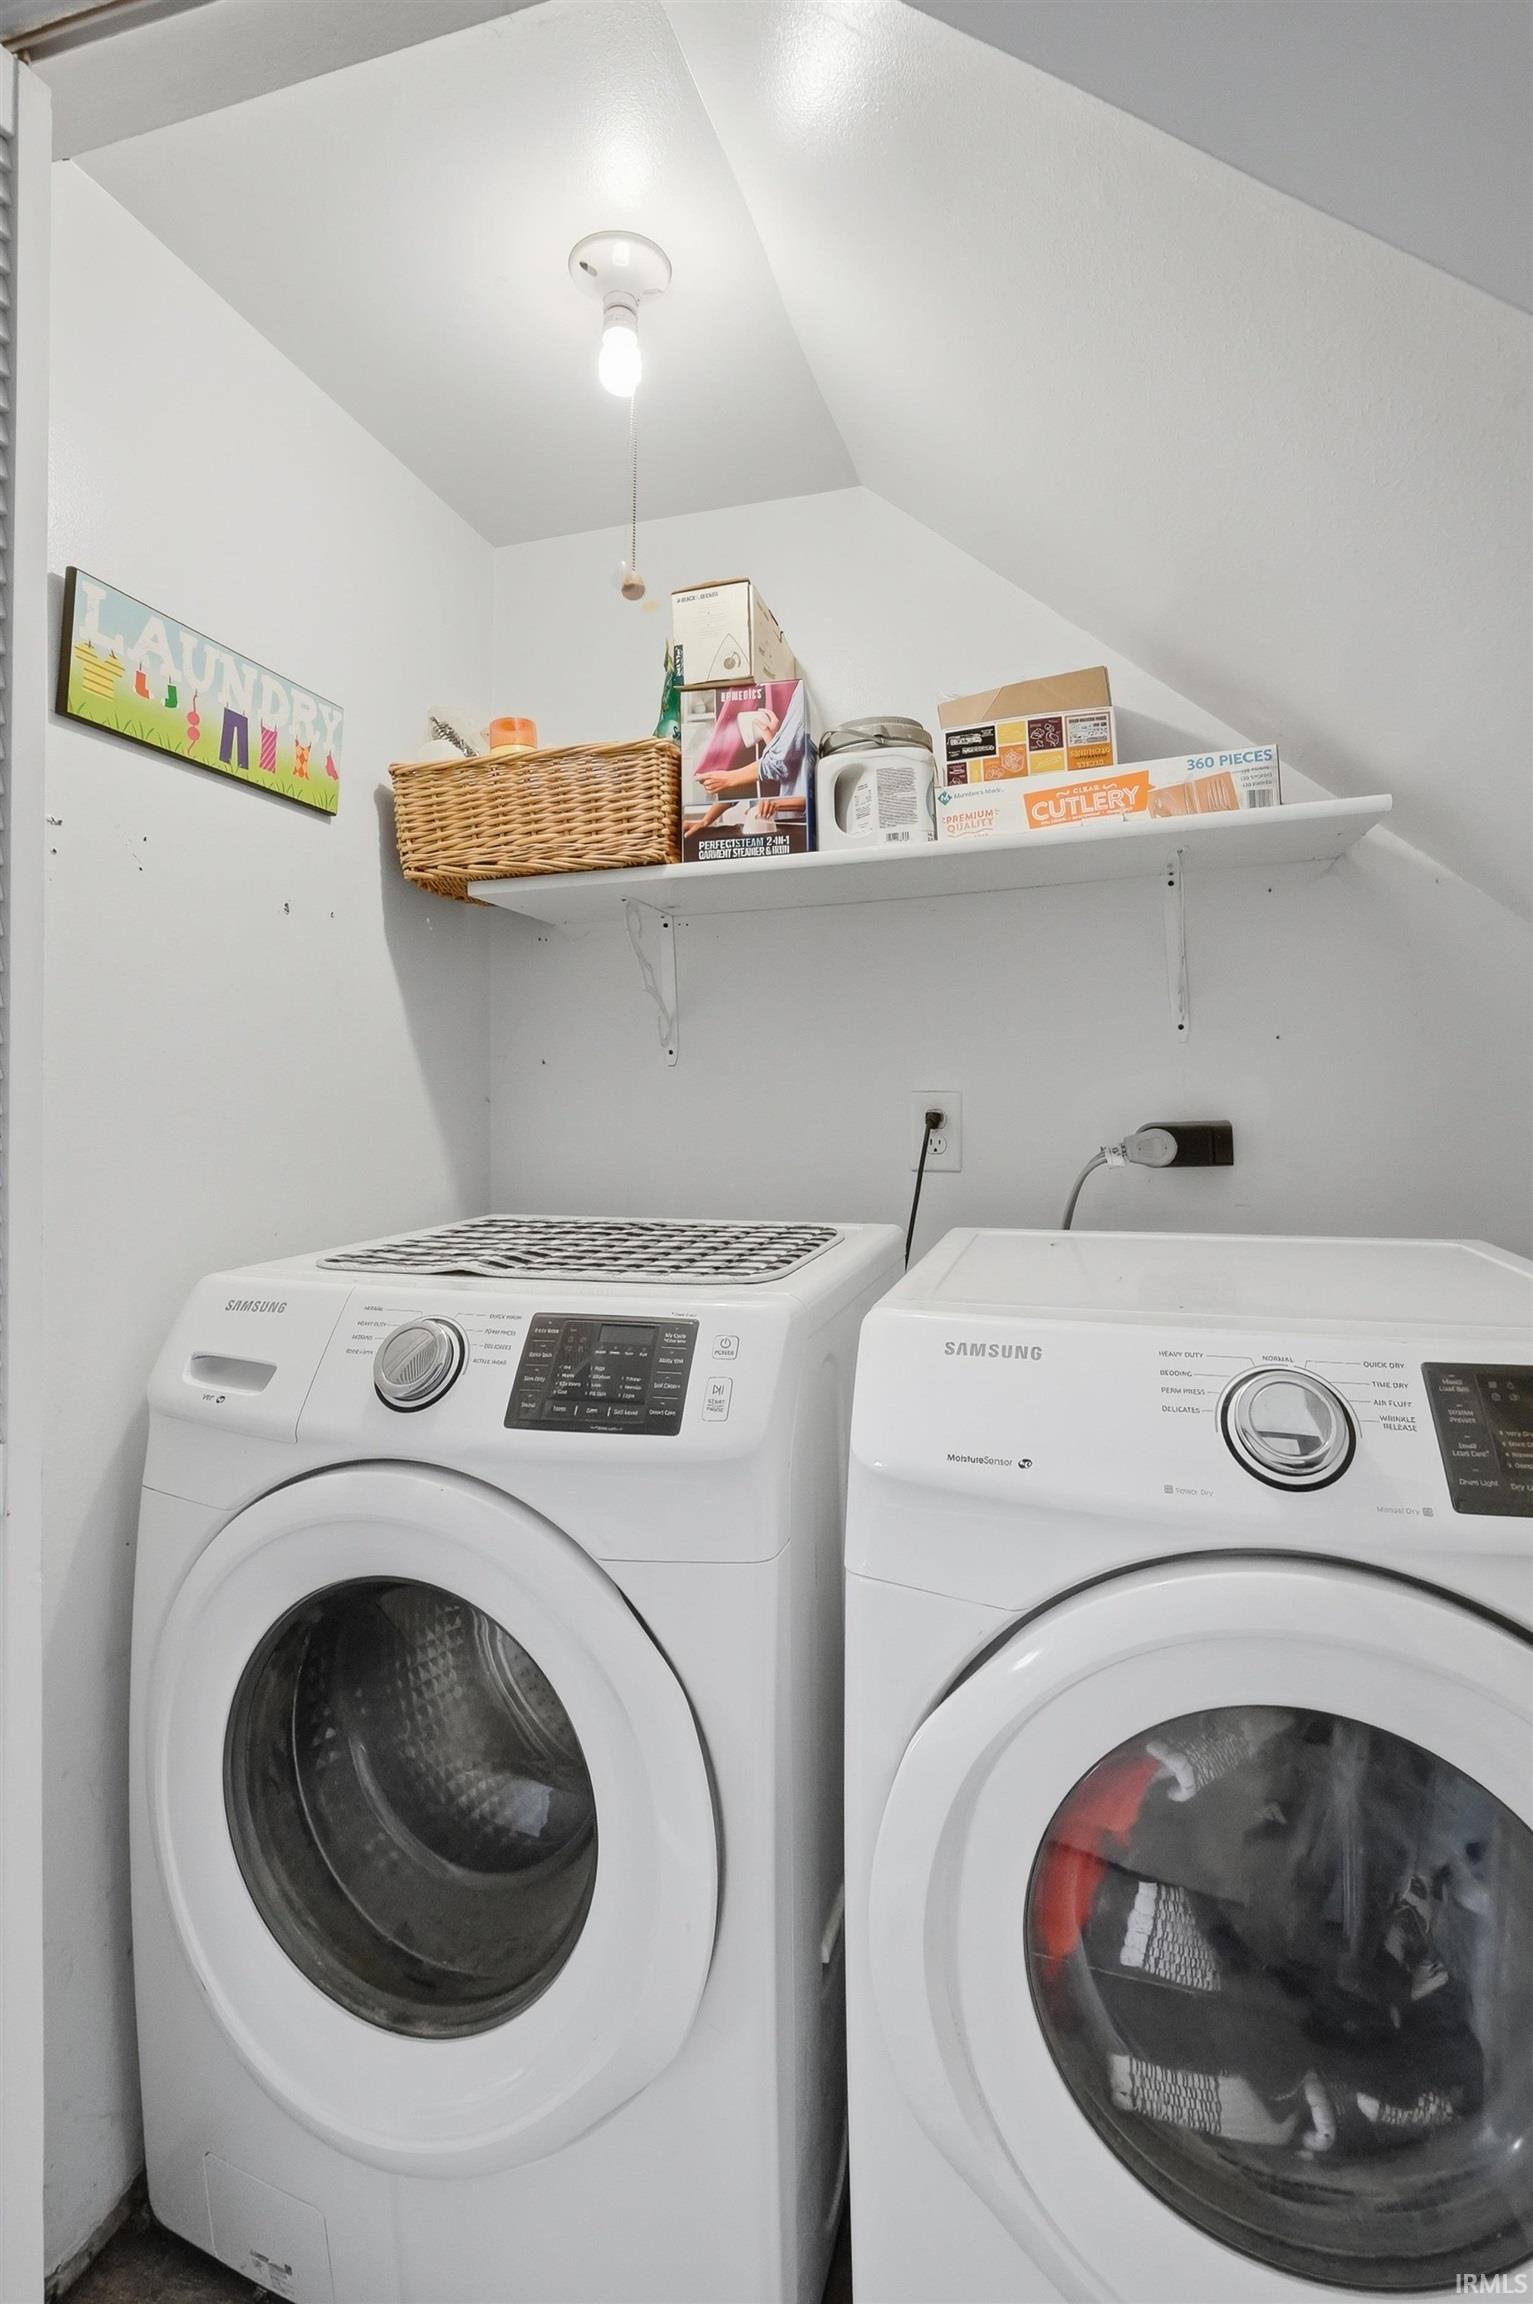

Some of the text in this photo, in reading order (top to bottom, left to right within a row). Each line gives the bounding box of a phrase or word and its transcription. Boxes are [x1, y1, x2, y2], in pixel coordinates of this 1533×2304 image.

[78, 580, 343, 748] LAUNDRY
[1187, 749, 1273, 771] 360 PIECES
[1073, 784, 1100, 794] CLEAR
[1031, 785, 1140, 821] CUTLERY
[946, 809, 993, 825] PREMIUM
[947, 817, 993, 833] QUALITY
[766, 835, 790, 846] 2-IN-1
[732, 847, 765, 858] STEAMER
[765, 847, 772, 856] &
[225, 1300, 288, 1314] SAMSUNG
[944, 1341, 1042, 1361] SAMSUNG
[1158, 1351, 1183, 1359] HEAVY
[1262, 1355, 1295, 1364] NORMAL
[1363, 1361, 1388, 1369] QUICK
[1160, 1370, 1192, 1378] BEDDING
[1371, 1381, 1409, 1390] TIME DRY
[1161, 1387, 1206, 1396] PERM PRESS
[1373, 1399, 1412, 1409] AIR FLUFF
[1161, 1405, 1201, 1414] DELICATES
[1379, 1415, 1416, 1424] WRINKLE
[1383, 1423, 1417, 1432] RELEASE
[947, 1453, 1013, 1467] MoistureSensor
[1406, 1507, 1420, 1516] Dry
